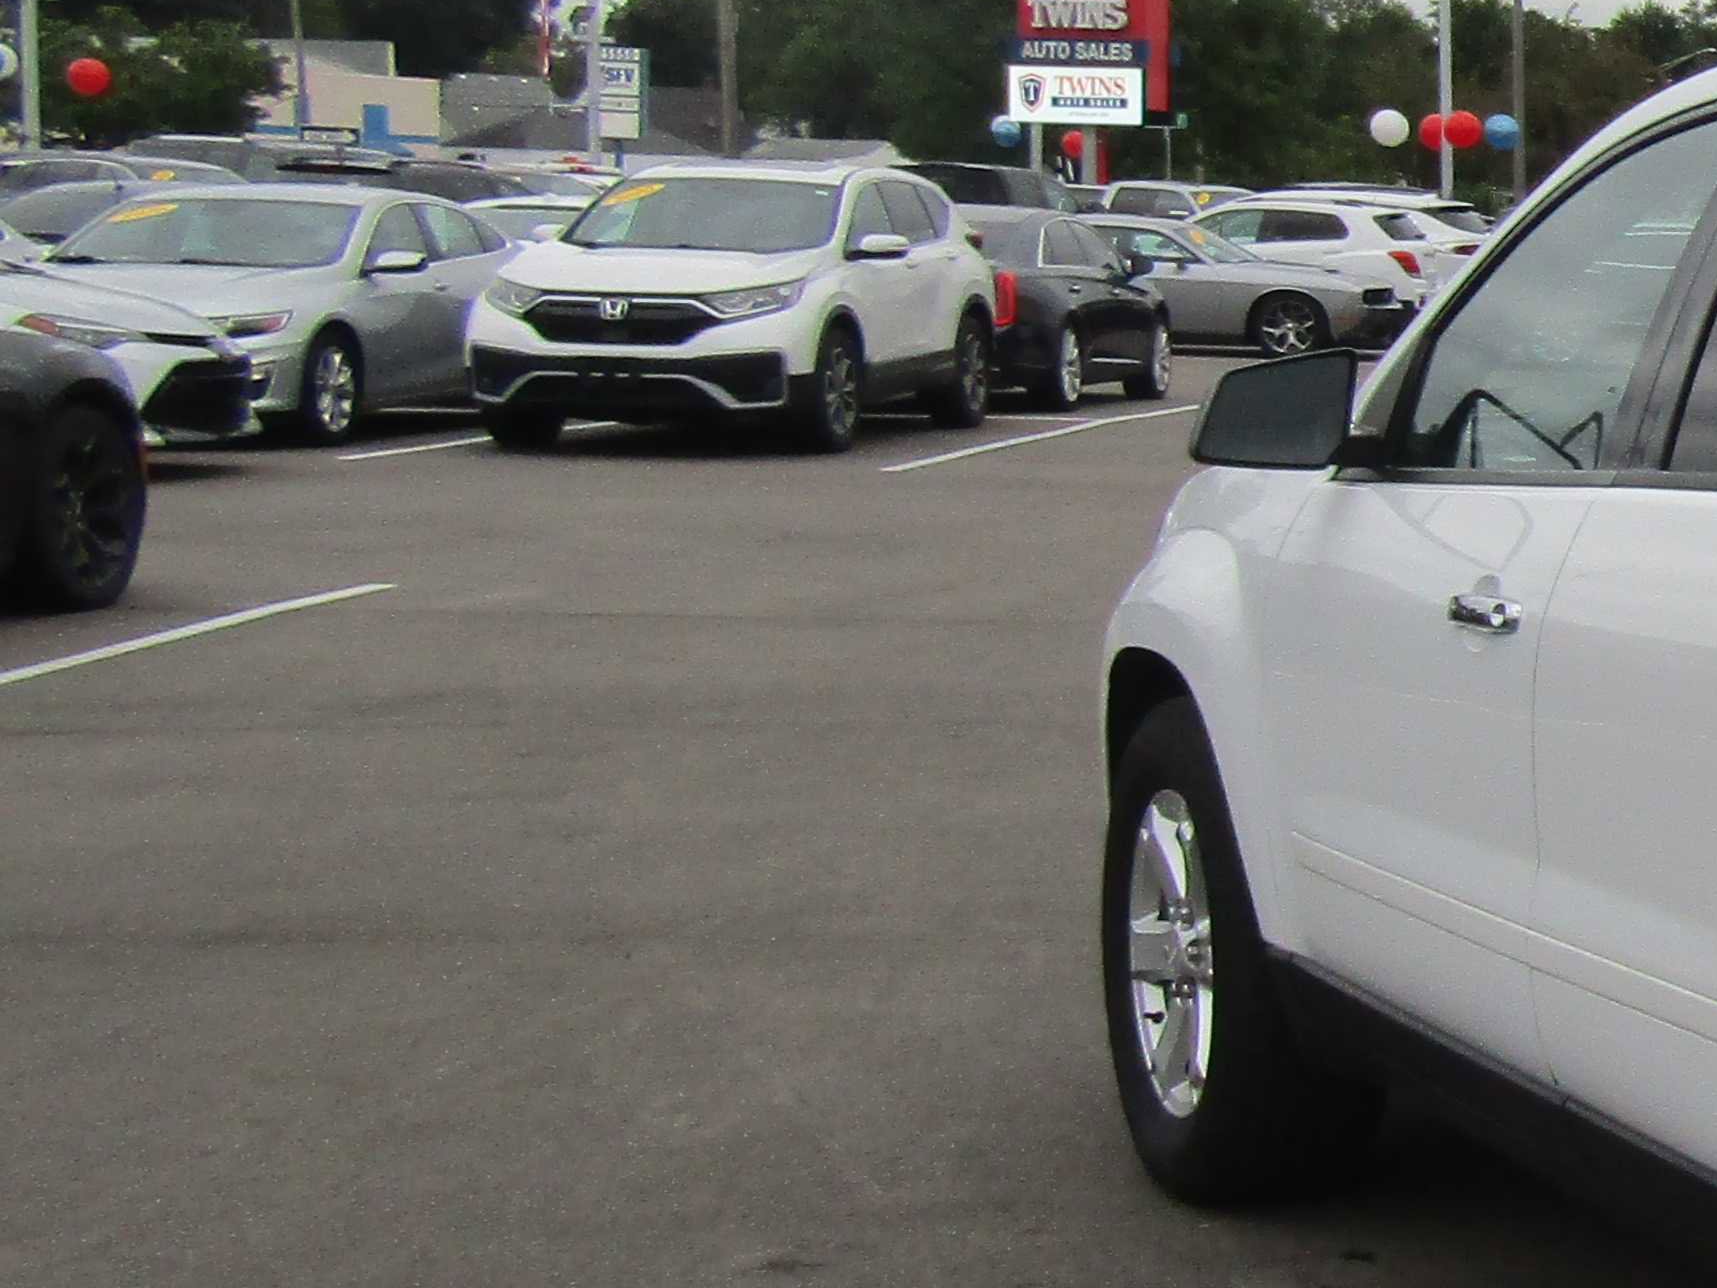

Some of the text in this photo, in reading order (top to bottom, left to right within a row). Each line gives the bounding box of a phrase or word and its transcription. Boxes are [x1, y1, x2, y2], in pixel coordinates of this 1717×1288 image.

[1022, 41, 1133, 62] AUTO SALES
[1054, 75, 1126, 96] TWINS
